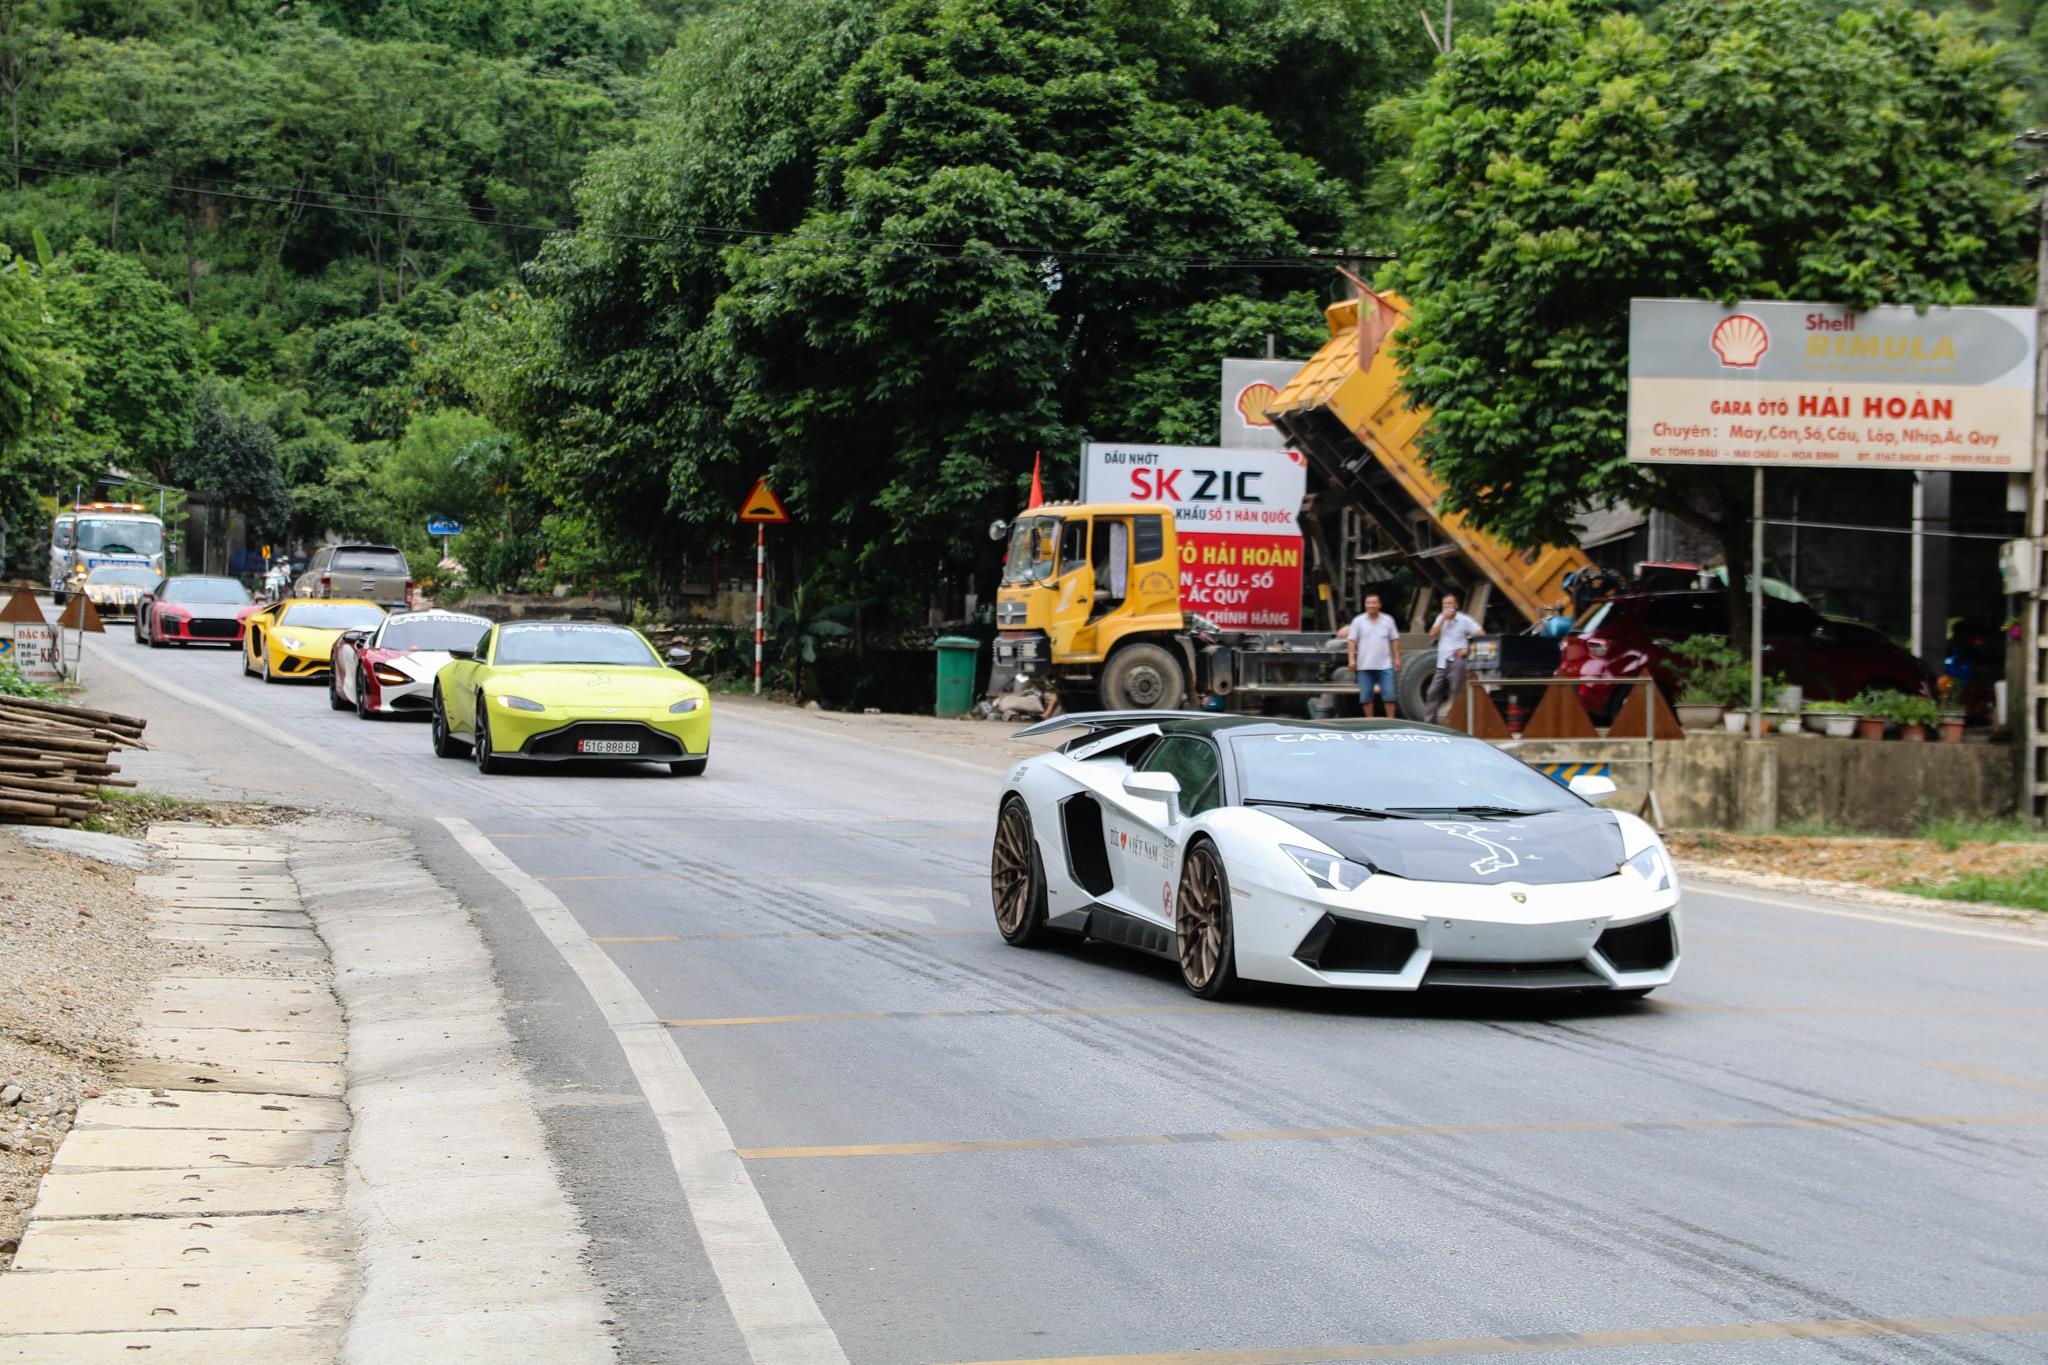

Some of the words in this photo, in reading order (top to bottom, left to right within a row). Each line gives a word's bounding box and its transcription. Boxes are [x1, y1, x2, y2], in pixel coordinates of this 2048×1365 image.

[1806, 313, 1856, 331] Shell
[1805, 335, 1956, 360] RIMULA
[1710, 400, 1752, 415] GARA
[1130, 467, 1182, 501] SK
[1188, 469, 1264, 503] ZIC
[1226, 510, 1231, 520] 1
[1202, 541, 1237, 566] HẢI
[1241, 543, 1298, 568] HOÀN
[1251, 570, 1275, 589] SỐ
[1213, 588, 1250, 605] QUY
[432, 615, 492, 628] PASSION
[1206, 608, 1249, 625] CHÍNH
[1274, 733, 1344, 743] CAR
[1351, 733, 1451, 744] PASSION
